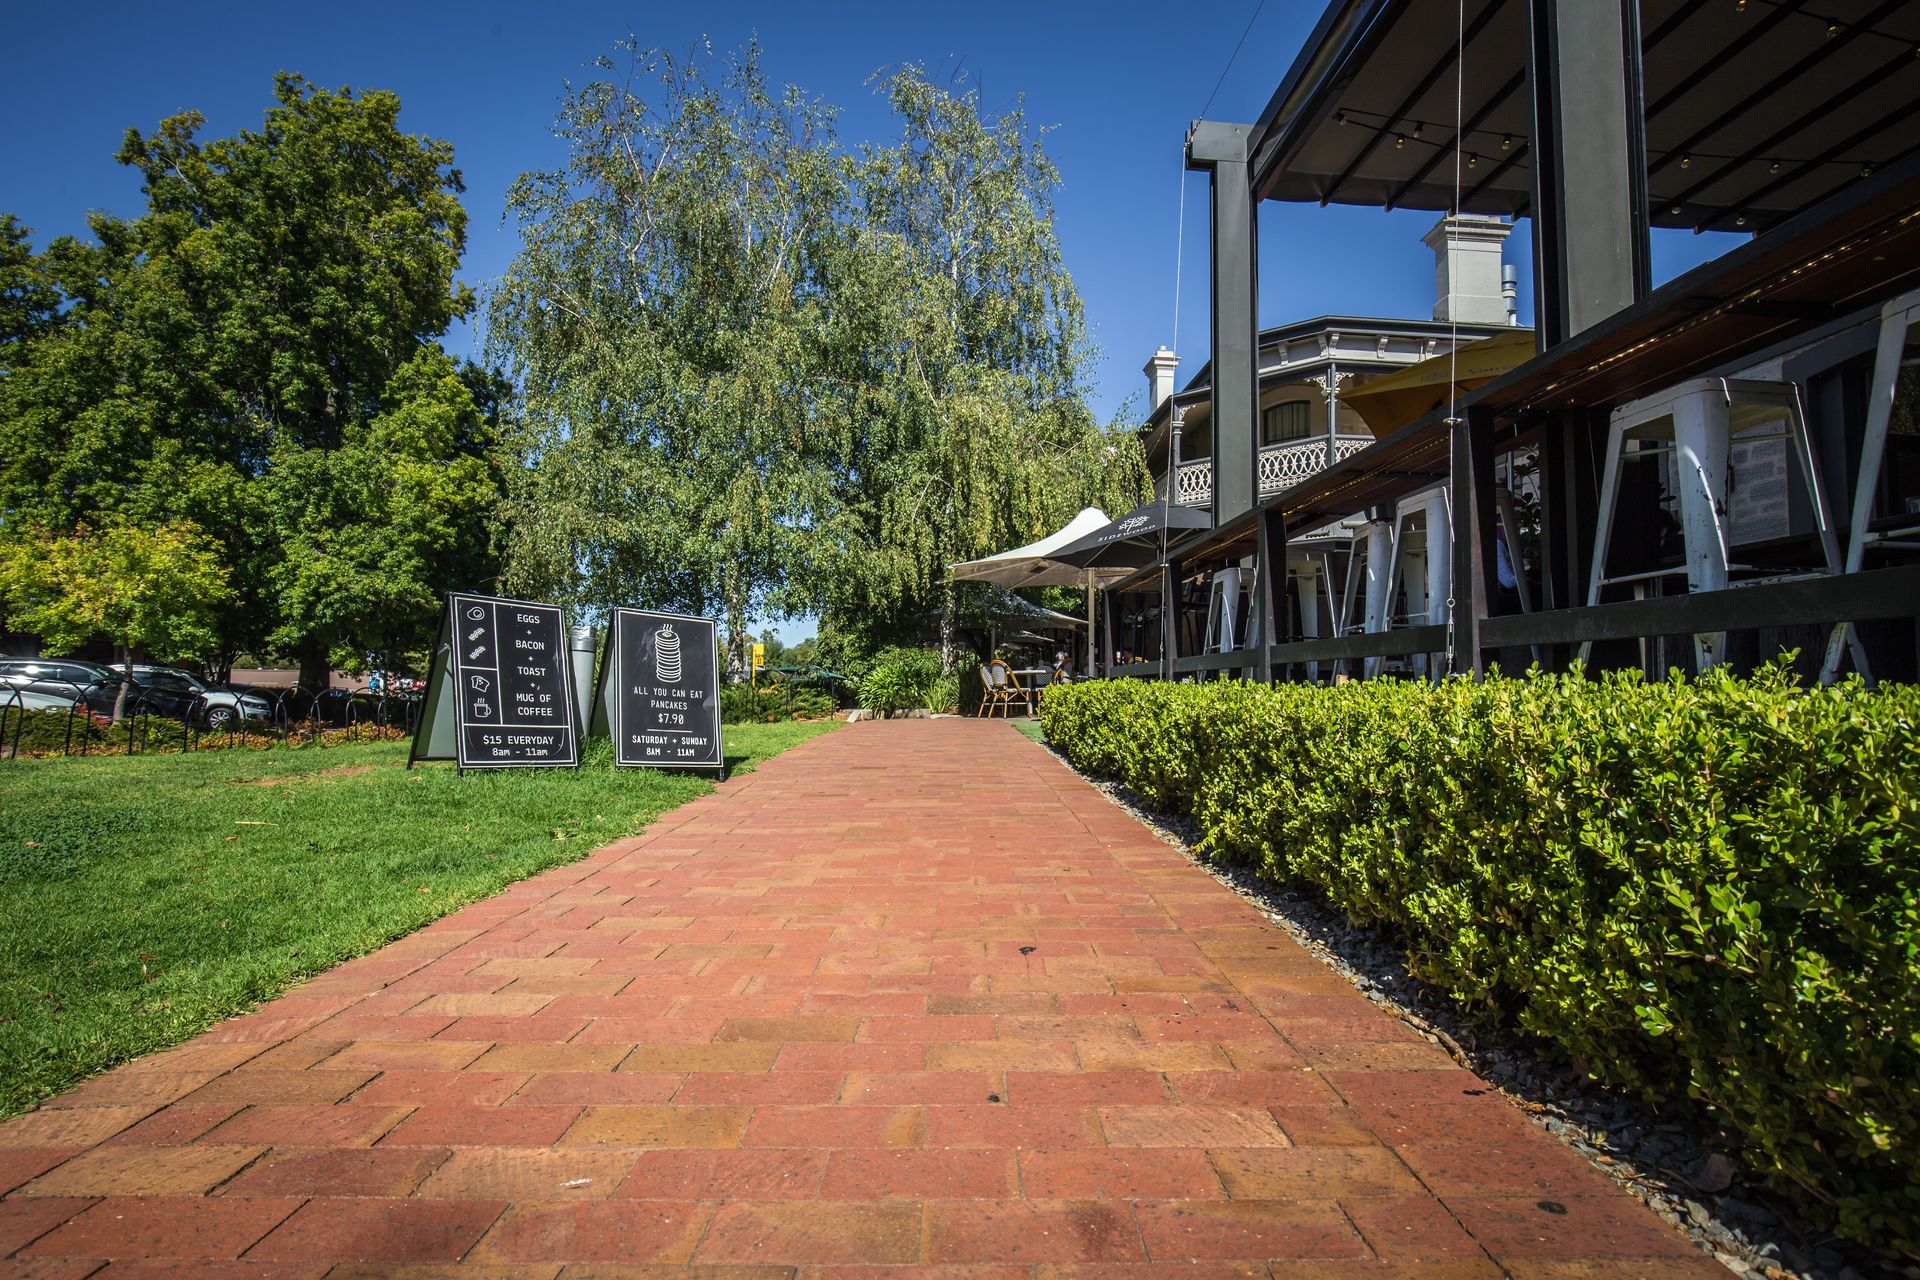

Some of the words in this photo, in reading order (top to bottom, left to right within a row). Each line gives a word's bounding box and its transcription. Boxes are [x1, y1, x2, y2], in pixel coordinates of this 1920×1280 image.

[1097, 524, 1156, 542] SIDEWOOD
[516, 613, 541, 624] EGGS
[515, 639, 545, 651] BACON
[517, 665, 546, 677] TOAST
[516, 693, 535, 703] MUG
[539, 693, 552, 703] OF
[633, 685, 649, 696] ALL
[653, 687, 668, 697] YOU
[671, 688, 686, 698] CAN
[690, 689, 704, 699] EAT
[650, 699, 688, 711] PANCAKES
[517, 706, 553, 717] COFFEE
[658, 712, 685, 725] $7.90
[483, 734, 502, 746] $15
[507, 735, 554, 745] EVERYDAY
[632, 735, 668, 745] SATURDAY
[681, 736, 708, 746] SUNDAY
[492, 747, 511, 757] 8am
[526, 747, 548, 757] 11am
[646, 747, 661, 756] 8AM
[677, 748, 695, 757] 11AM
